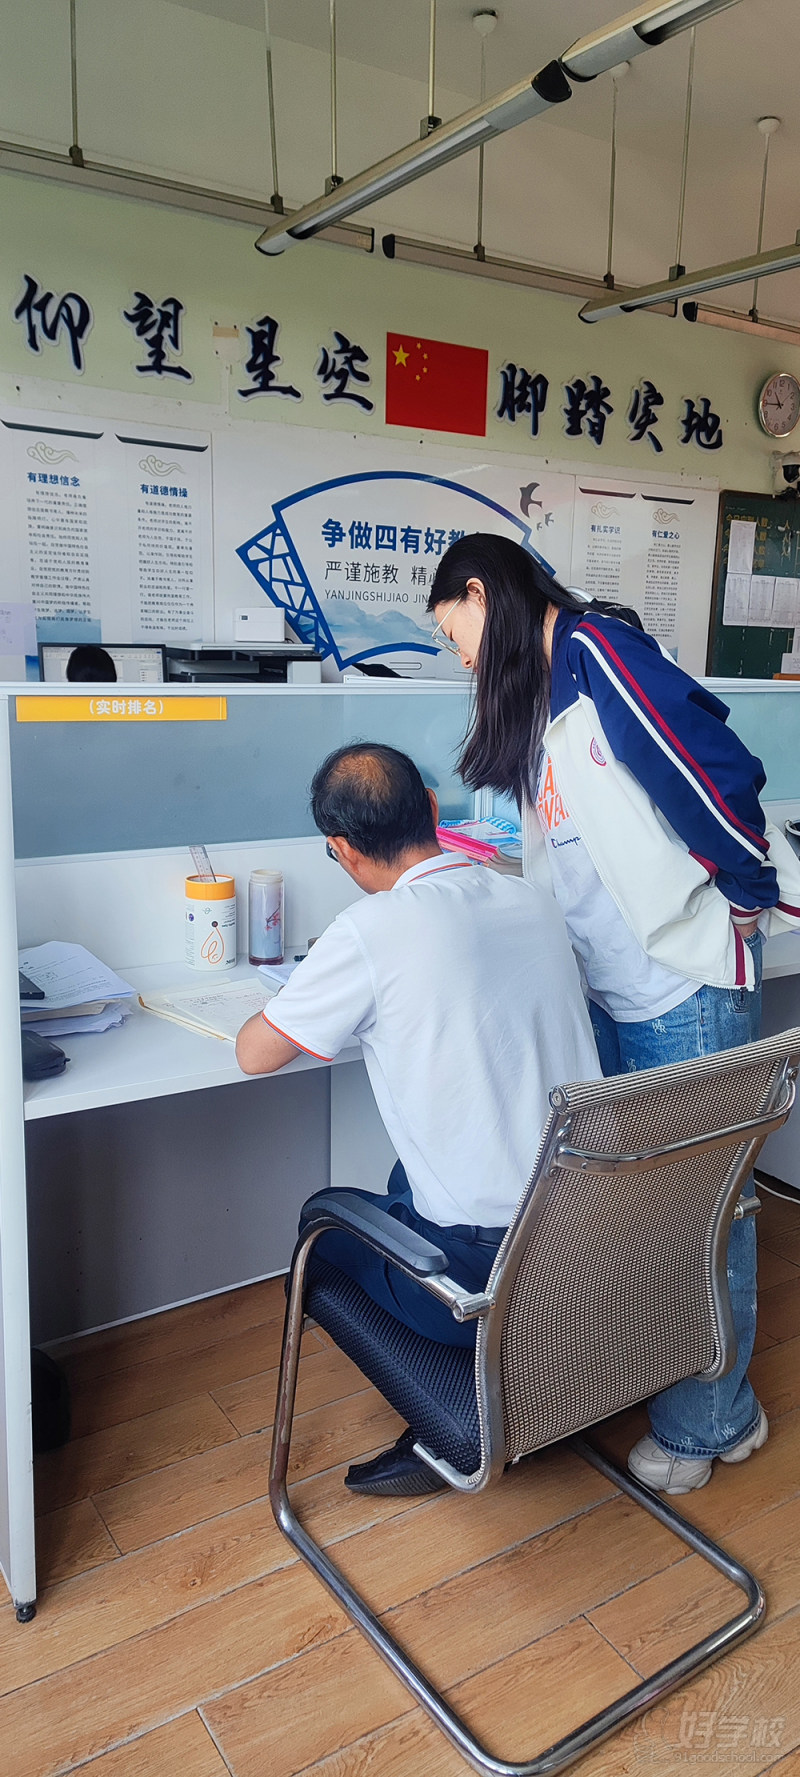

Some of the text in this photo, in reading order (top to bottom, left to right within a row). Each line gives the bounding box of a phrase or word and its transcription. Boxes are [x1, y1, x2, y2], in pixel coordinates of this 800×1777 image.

[26, 471, 81, 488] 有理想信念
[139, 483, 188, 499] 有道德情操
[590, 524, 621, 535] 有扎实学识
[651, 530, 680, 539] 有仁爱之心
[324, 560, 399, 585] 严谨施教
[324, 588, 409, 604] YANJINGSHIJIAO
